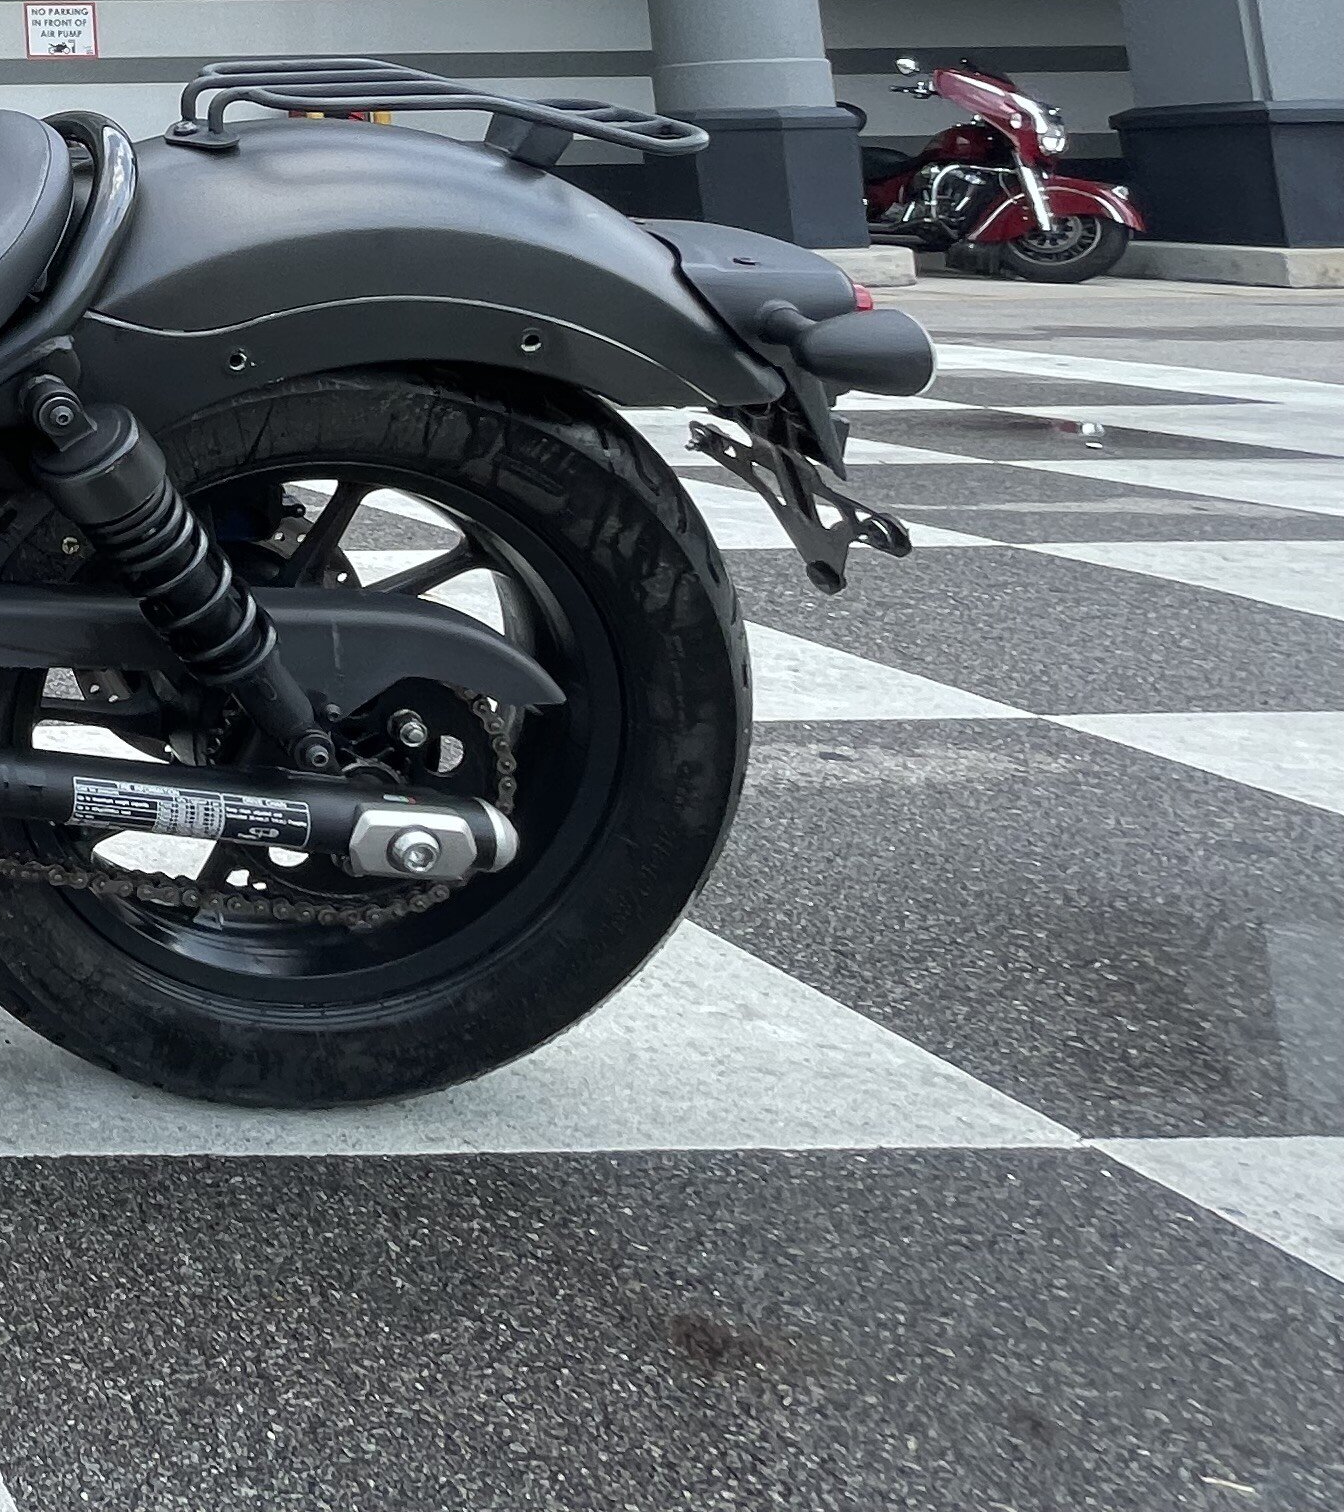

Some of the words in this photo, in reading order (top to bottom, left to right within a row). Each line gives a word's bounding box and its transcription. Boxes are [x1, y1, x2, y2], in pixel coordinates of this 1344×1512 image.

[31, 7, 46, 16] NO
[48, 7, 89, 16] PARKING
[31, 18, 42, 27] IN
[44, 18, 72, 27] FRONT
[74, 18, 87, 27] OF
[40, 29, 56, 38] AIR
[57, 29, 82, 38] PUMP
